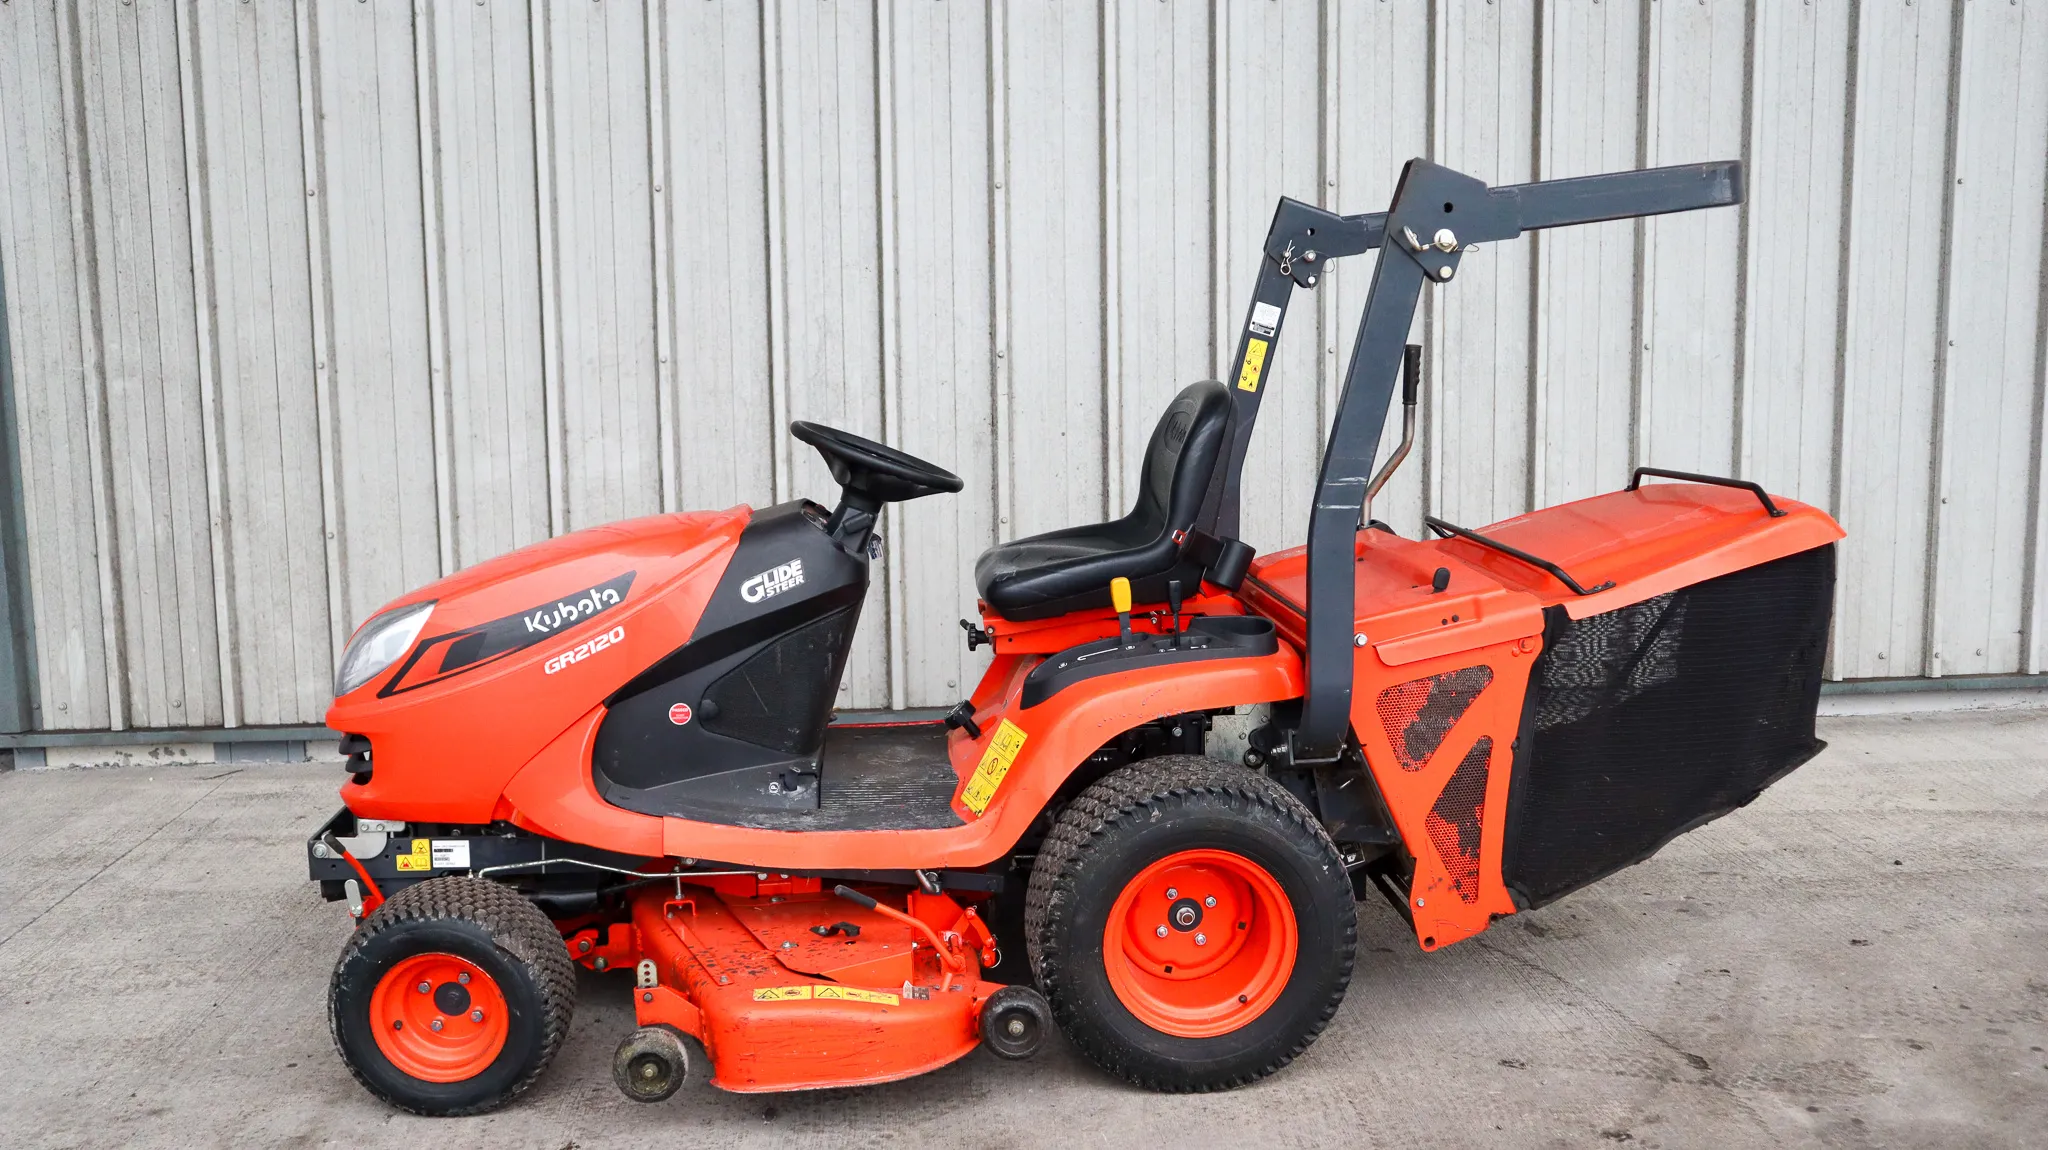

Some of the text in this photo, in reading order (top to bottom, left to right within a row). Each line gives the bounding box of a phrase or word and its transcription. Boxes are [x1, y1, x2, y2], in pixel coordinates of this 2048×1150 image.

[741, 559, 803, 603] GLIDE
[766, 575, 804, 597] STEER
[523, 588, 620, 632] Kubota
[544, 625, 625, 675] GR2120
